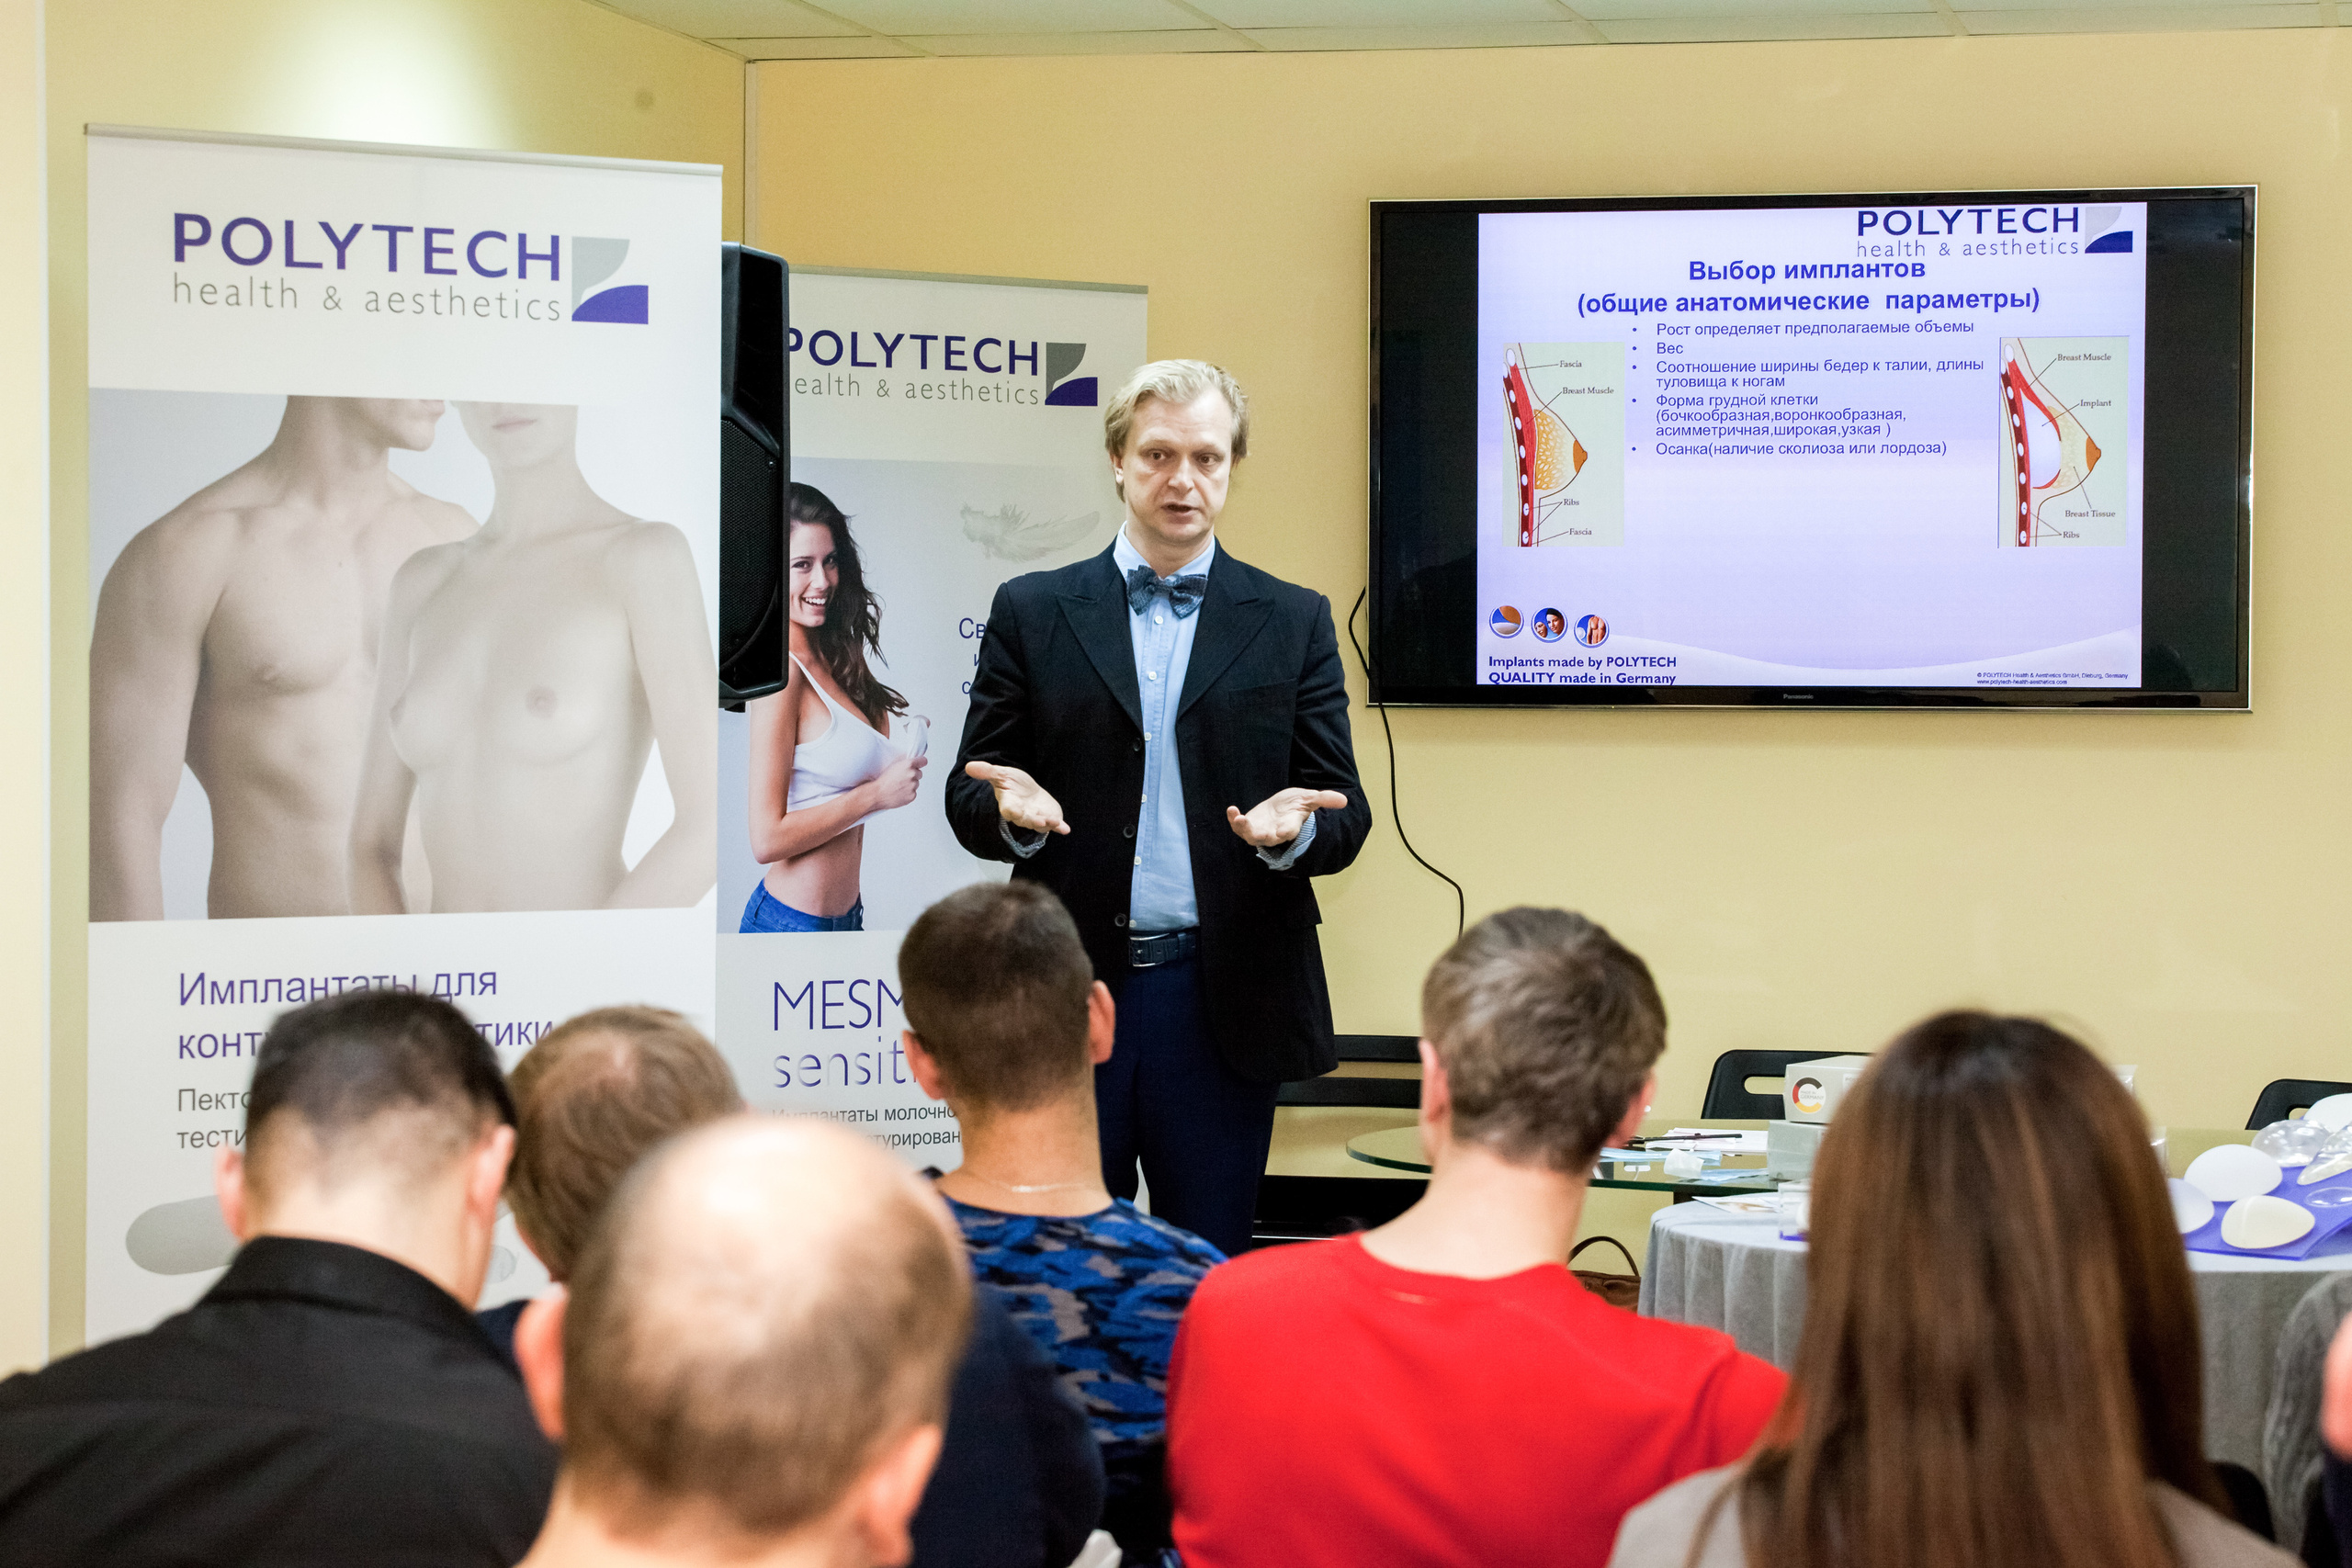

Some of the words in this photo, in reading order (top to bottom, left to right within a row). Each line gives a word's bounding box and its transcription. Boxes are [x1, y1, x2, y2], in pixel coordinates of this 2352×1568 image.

[1858, 207, 2079, 236] POLYTECH
[173, 212, 560, 282] POLYTECH
[1857, 239, 1926, 257] health
[1939, 243, 1951, 256] &
[1962, 237, 2079, 256] aesthetics
[1689, 260, 1776, 284] Выбор
[1784, 261, 1926, 280] имплантов
[174, 273, 299, 310] health
[322, 286, 343, 311] &
[365, 287, 561, 321] aesthetics
[1577, 293, 1668, 318] (общие
[1675, 294, 1870, 312] анатомические
[1885, 288, 2040, 314] параметры)
[1657, 323, 1690, 336] Рост
[1694, 324, 1781, 338] определяет
[1785, 322, 1910, 338] предполагаемые
[1915, 320, 1974, 333] объемы
[789, 327, 1038, 377] POLYTECH
[1657, 342, 1684, 355] Вес
[1656, 360, 1757, 374] Соотношение
[1760, 361, 1819, 375] ширины
[1824, 359, 1869, 374] бедер
[1872, 361, 1881, 371] к
[1884, 360, 1931, 372] талии,
[1936, 359, 1984, 373] длины
[794, 372, 861, 397] ealth
[876, 378, 890, 398] &
[905, 378, 1039, 405] aesthetics
[1656, 377, 1727, 390] туловища
[1731, 378, 1739, 387] к
[1743, 377, 1785, 387] ногам
[1656, 394, 1704, 409] Форма
[1709, 393, 1766, 409] грудной
[1770, 395, 1819, 406] клетки
[2080, 400, 2112, 408] Implant
[1656, 442, 1774, 457] Осанка(наличие
[1779, 444, 1845, 455] сколиоза
[1849, 444, 1876, 454] или
[1880, 441, 1947, 457] лордоза)
[1569, 527, 1592, 536] Fascia
[2063, 531, 2080, 539] Ribs
[958, 617, 987, 639] Св
[1488, 656, 1544, 670] Implants
[1548, 656, 1585, 668] made
[1588, 656, 1603, 670] by
[1607, 656, 1677, 668] POLYTECH
[1488, 671, 1555, 684] QUALITY
[1559, 671, 1597, 683] made
[1600, 672, 1611, 683] in
[1616, 672, 1677, 685] Germany
[431, 970, 498, 1003] для
[774, 978, 904, 1031] MESM
[178, 1031, 270, 1060] конт
[474, 1021, 553, 1047] тики
[773, 1035, 917, 1089] sensit
[178, 1088, 252, 1111] Пекто
[884, 1105, 956, 1122] молочно
[176, 1129, 246, 1148] тести
[866, 1130, 961, 1149] турирован
